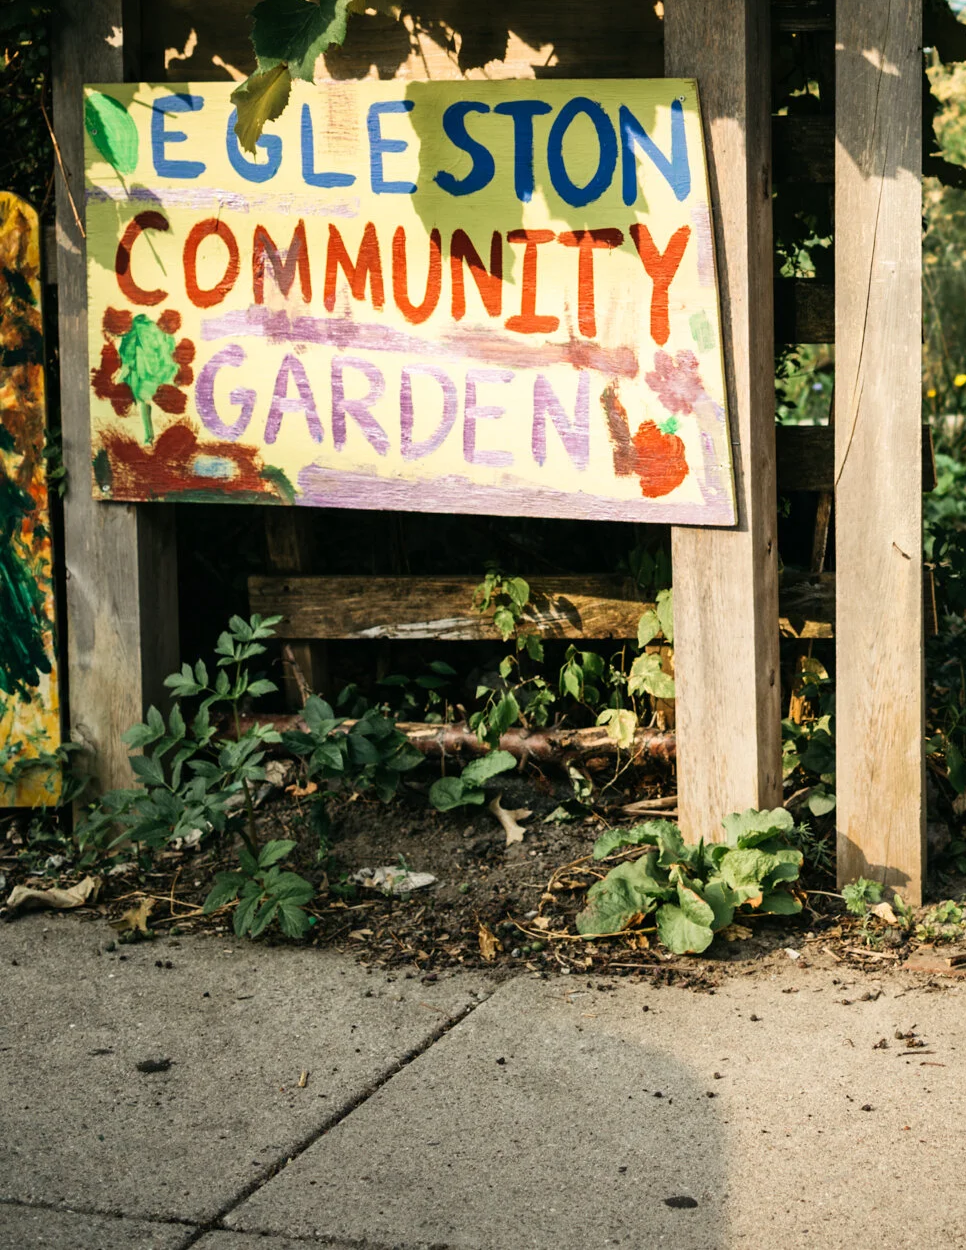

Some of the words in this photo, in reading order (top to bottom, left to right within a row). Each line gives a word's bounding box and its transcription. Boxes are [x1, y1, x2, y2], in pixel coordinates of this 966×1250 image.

[150, 94, 692, 208] EGLESTON
[114, 209, 692, 346] COMMUNITY
[194, 343, 591, 472] GARDEN
